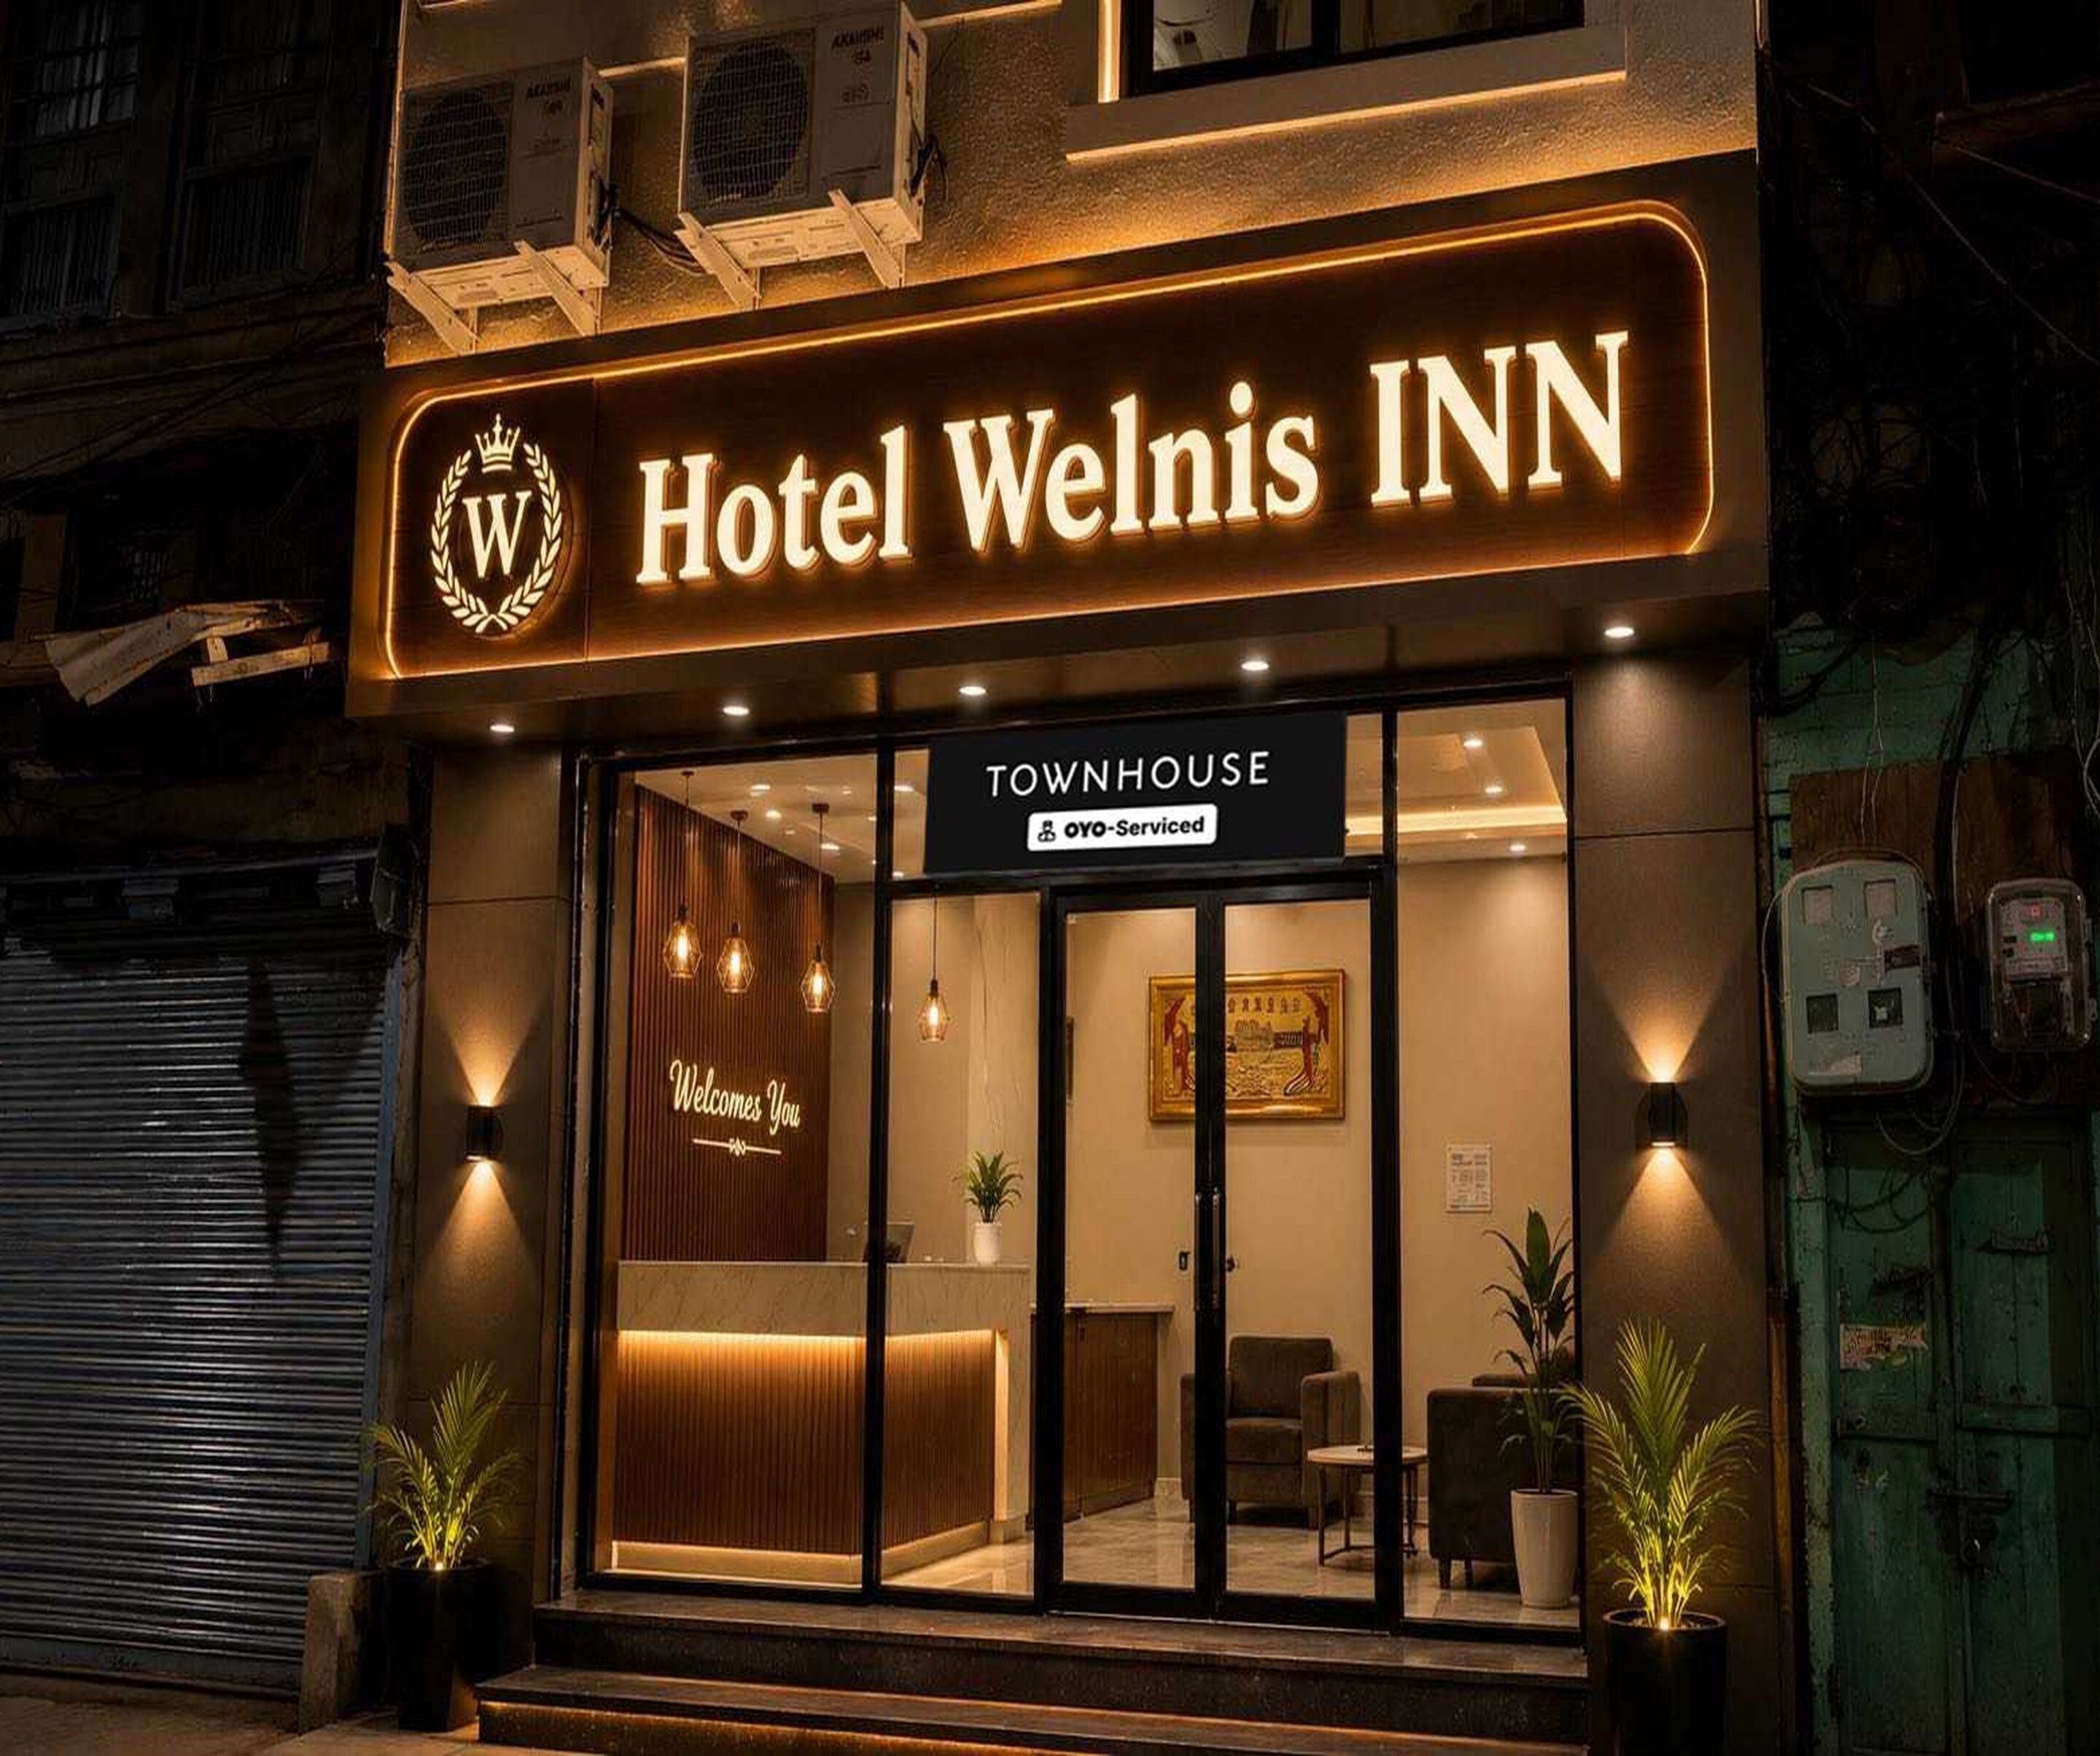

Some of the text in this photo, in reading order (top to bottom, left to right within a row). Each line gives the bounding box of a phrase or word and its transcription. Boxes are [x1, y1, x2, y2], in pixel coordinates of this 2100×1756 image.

[635, 330, 1629, 585] Hotel Welnis INN
[461, 489, 533, 580] W
[986, 750, 1270, 797] TOWNHOUSE
[1064, 815, 1205, 839] OYO-Serviced
[669, 1058, 801, 1136] Welcomes You
